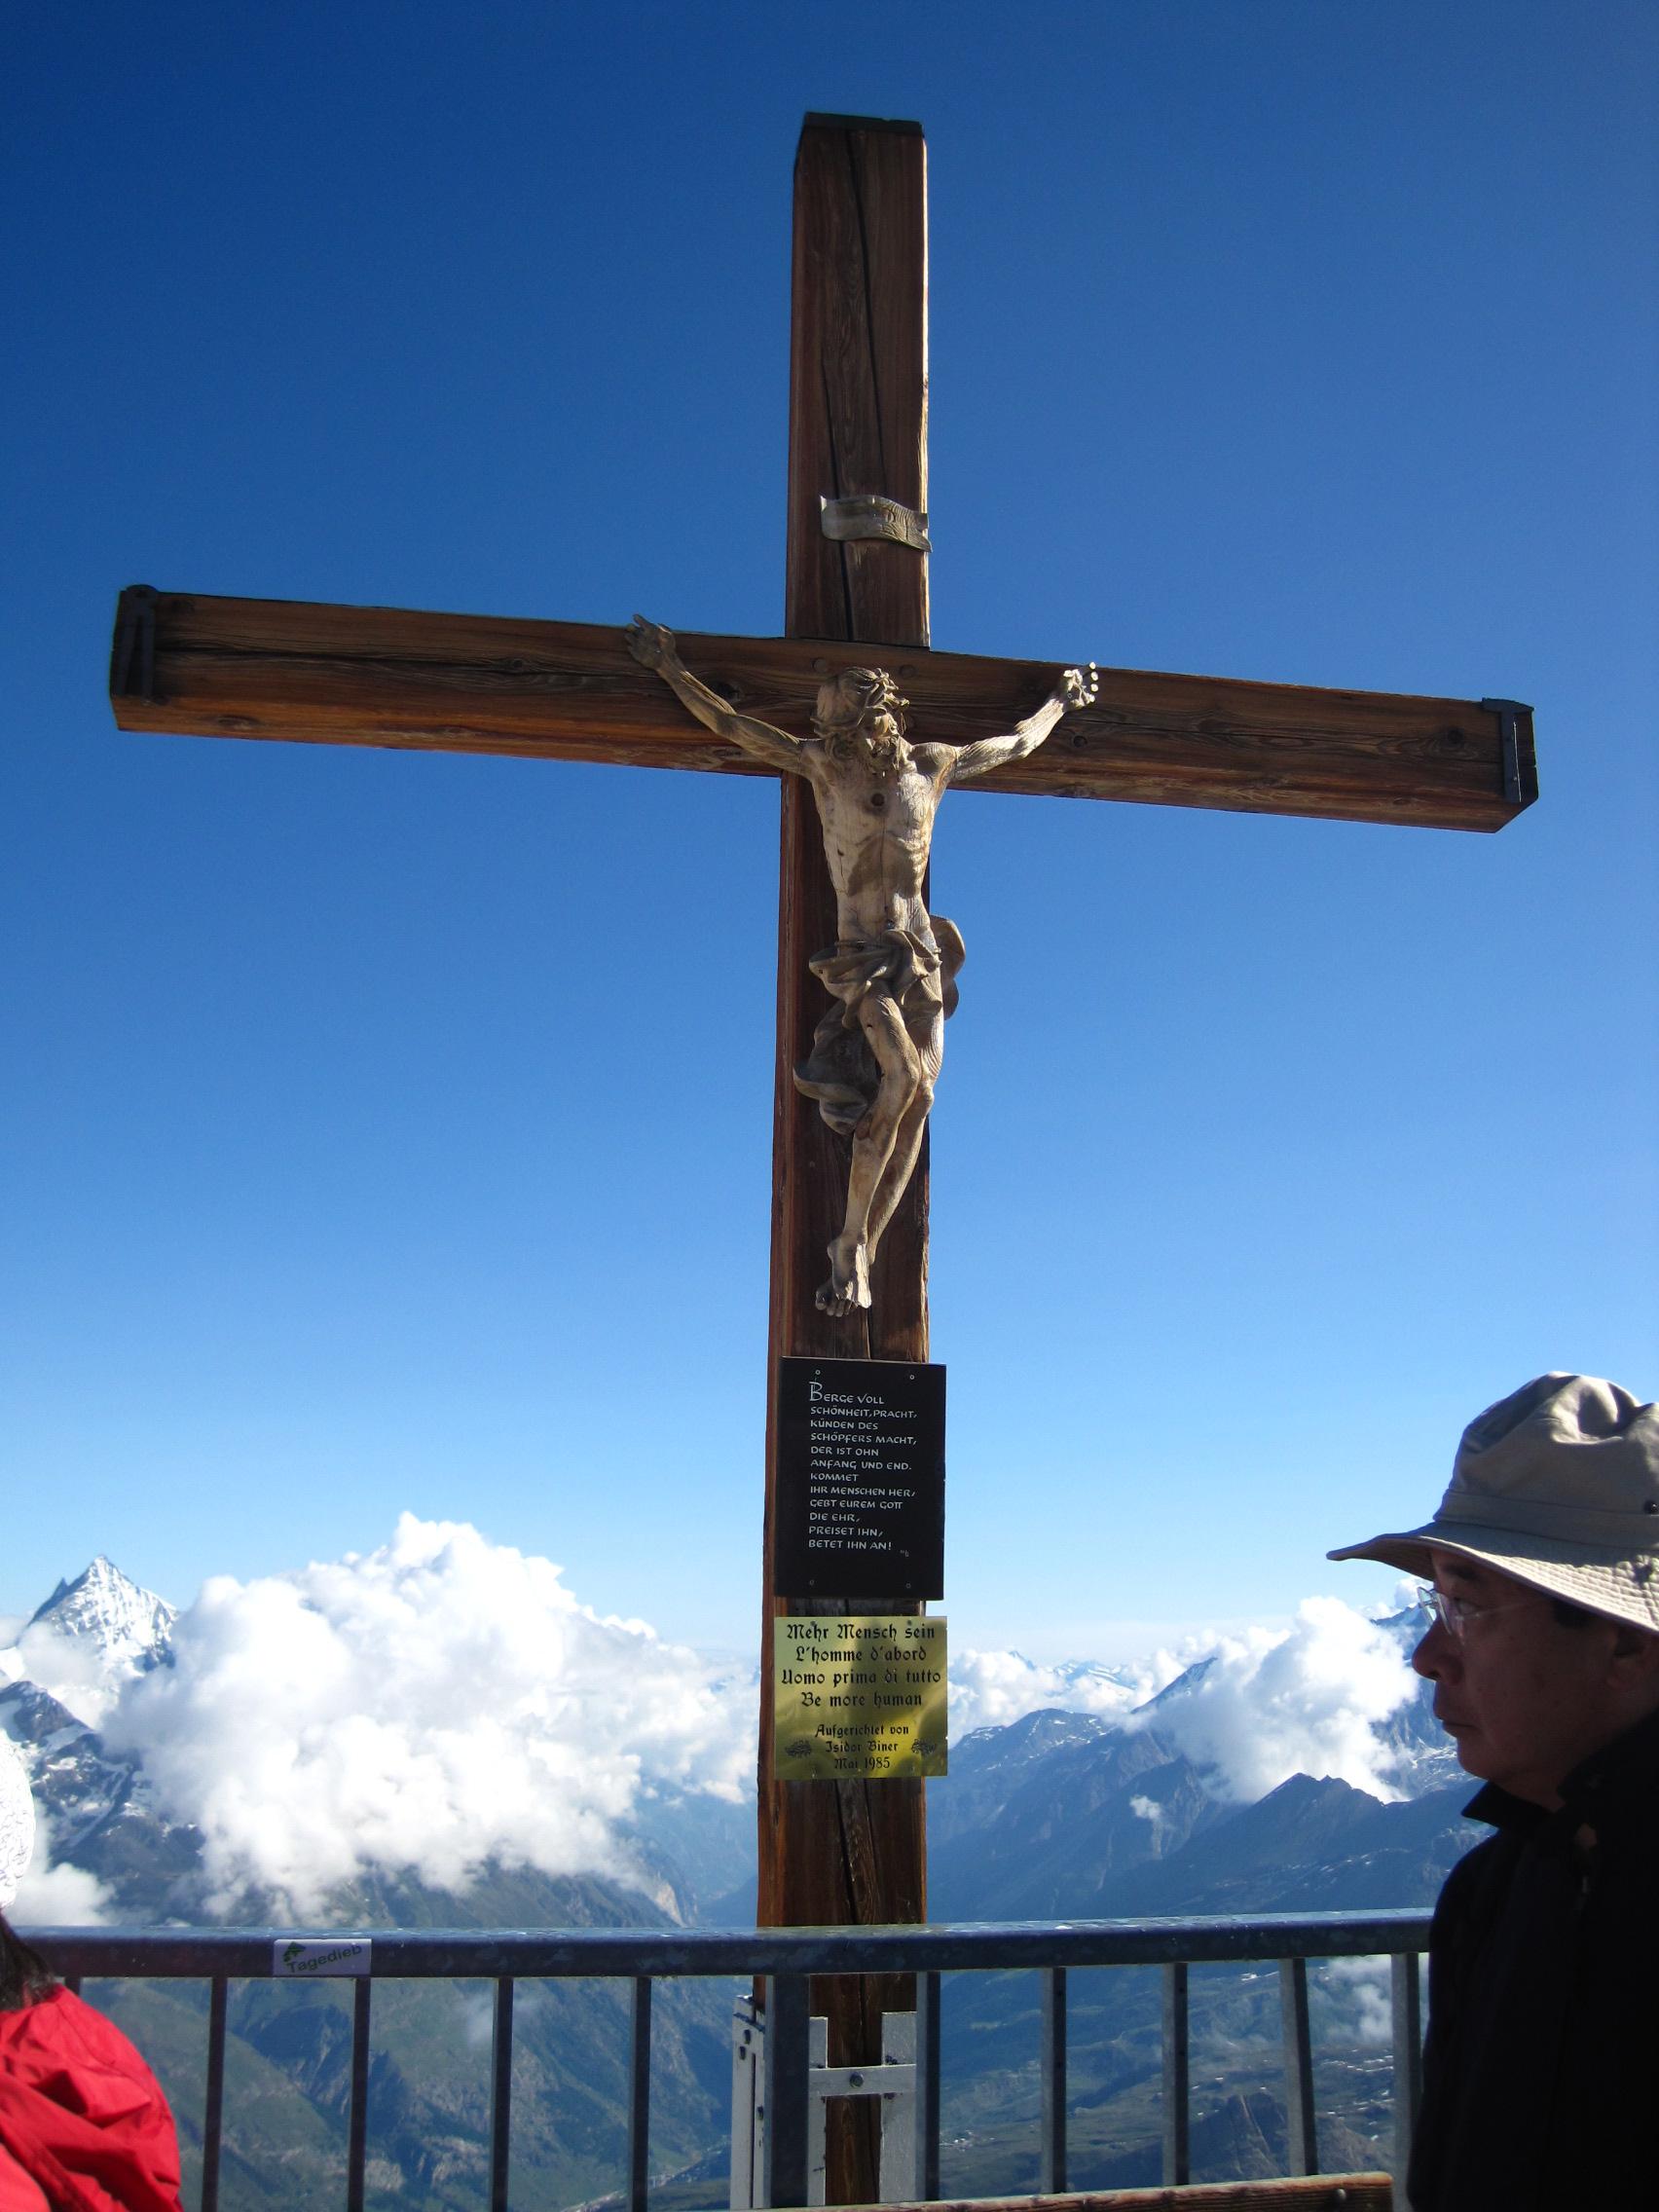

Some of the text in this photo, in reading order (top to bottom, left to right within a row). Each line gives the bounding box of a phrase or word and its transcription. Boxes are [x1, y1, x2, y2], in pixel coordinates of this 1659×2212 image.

[809, 1381, 885, 1405] BERGE VOLL
[810, 1418, 878, 1430] KÜNDEN DES
[810, 1432, 917, 1445] SCHÖPFERS MACHT,
[810, 1459, 857, 1470] ANFANG
[810, 1473, 859, 1482] KOMMET
[830, 1487, 885, 1495] MENSCHEN
[810, 1499, 837, 1508] GEBT
[809, 1527, 854, 1535] PREISET
[808, 1539, 842, 1548] BETET
[869, 1541, 892, 1550] AN!
[787, 1624, 935, 1642] Mehr Mensch sein
[782, 1669, 826, 1685] Uomo
[884, 1669, 898, 1683] di
[906, 1671, 940, 1683] tutto
[801, 1692, 922, 1709] Be more human
[815, 1724, 909, 1739] Aufgerichtet von
[867, 1741, 898, 1752] Biner
[834, 1757, 891, 1770] Mai 1985
[287, 1944, 362, 1972] Tagedieb
